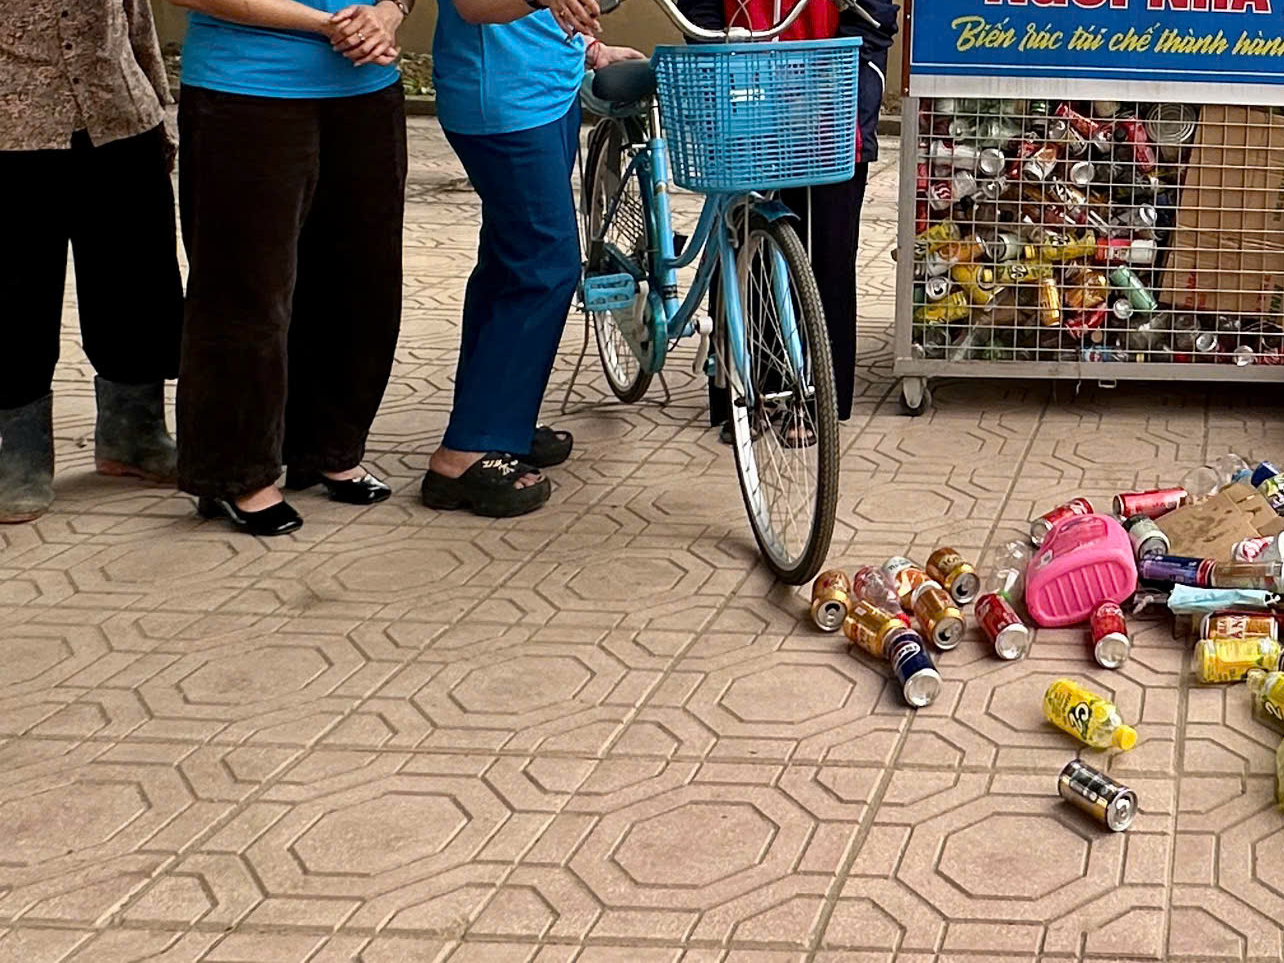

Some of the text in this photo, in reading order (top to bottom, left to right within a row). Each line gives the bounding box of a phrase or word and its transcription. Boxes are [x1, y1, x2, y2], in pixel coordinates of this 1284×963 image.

[951, 15, 1017, 52] Biến
[1018, 22, 1063, 53] rác
[1068, 25, 1108, 51] tái
[1108, 22, 1161, 52] chế
[1154, 27, 1229, 56] thành
